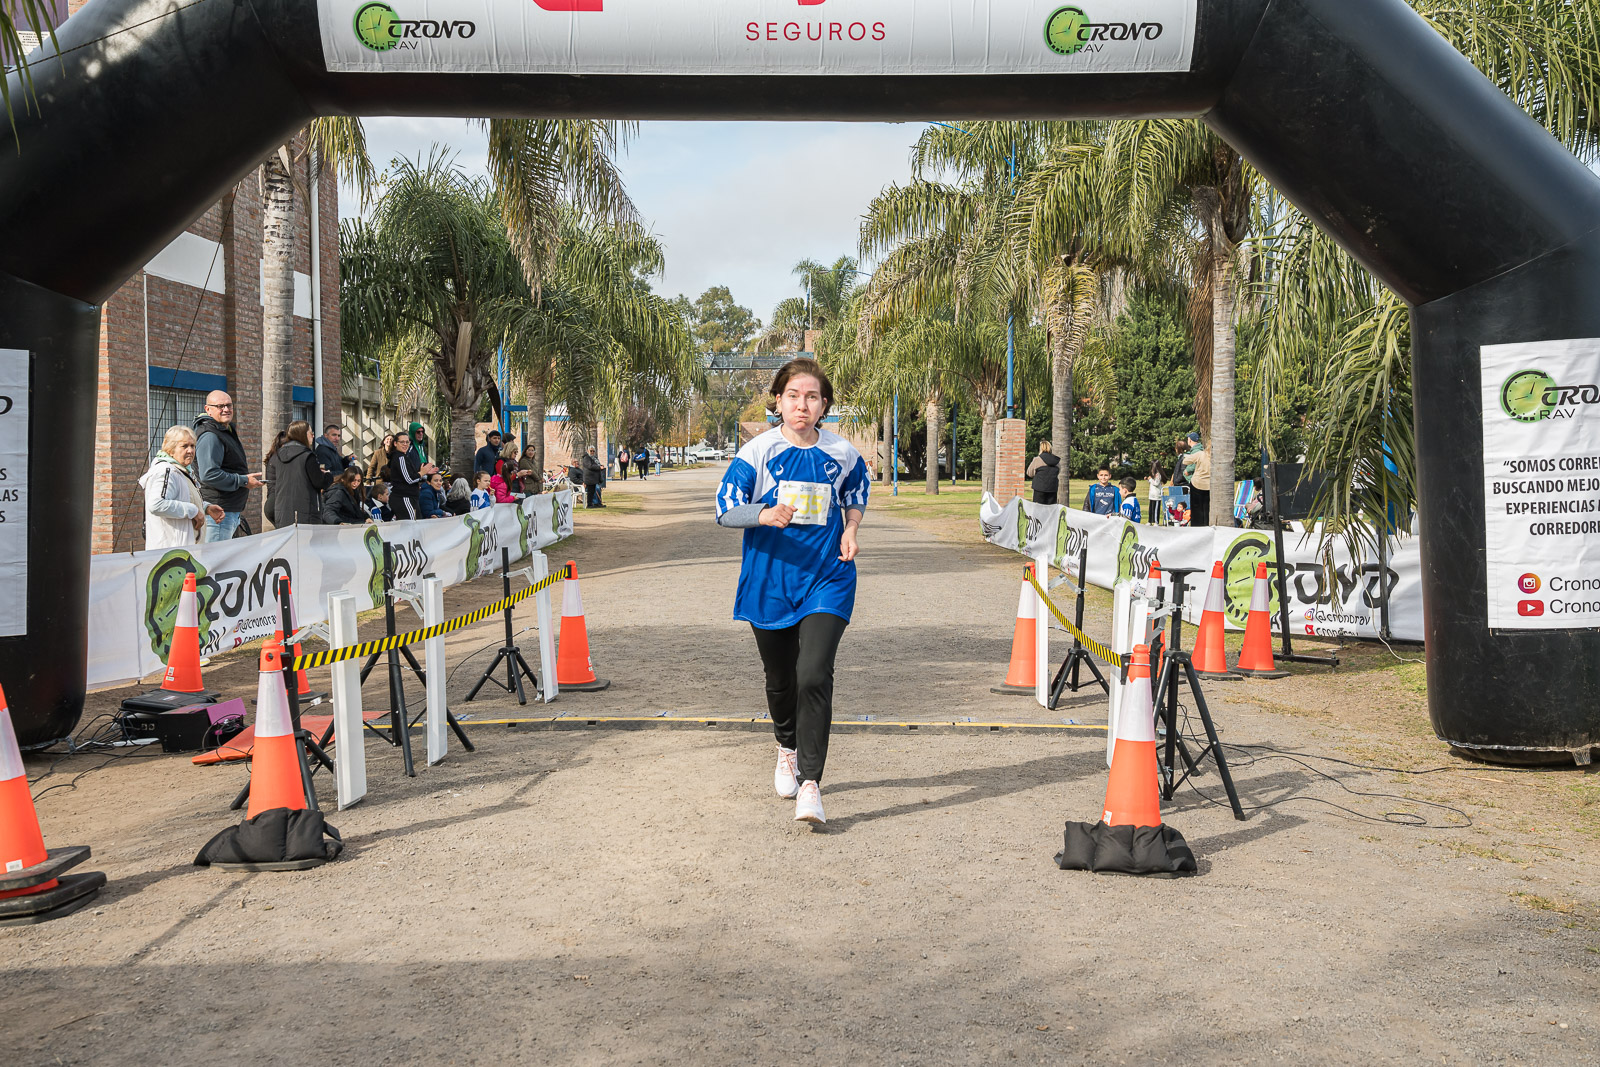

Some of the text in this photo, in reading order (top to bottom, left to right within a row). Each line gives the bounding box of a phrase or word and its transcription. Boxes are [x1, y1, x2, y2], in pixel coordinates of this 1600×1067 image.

[388, 20, 476, 39] CRONO
[746, 22, 886, 41] SEGUROS
[1077, 22, 1163, 41] CRONO
[388, 41, 418, 50] RAV
[1073, 44, 1104, 53] RAV
[1541, 385, 1600, 406] CRO
[1540, 408, 1576, 420] RAV
[1558, 457, 1600, 471] CORRE
[1493, 479, 1564, 495] BUSCANDO
[784, 493, 824, 515] 735
[1506, 499, 1595, 515] EXPERIENCIAS
[1529, 521, 1600, 535] CORREDOR
[1315, 610, 1371, 626] @cronorav
[200, 627, 226, 656] AV
